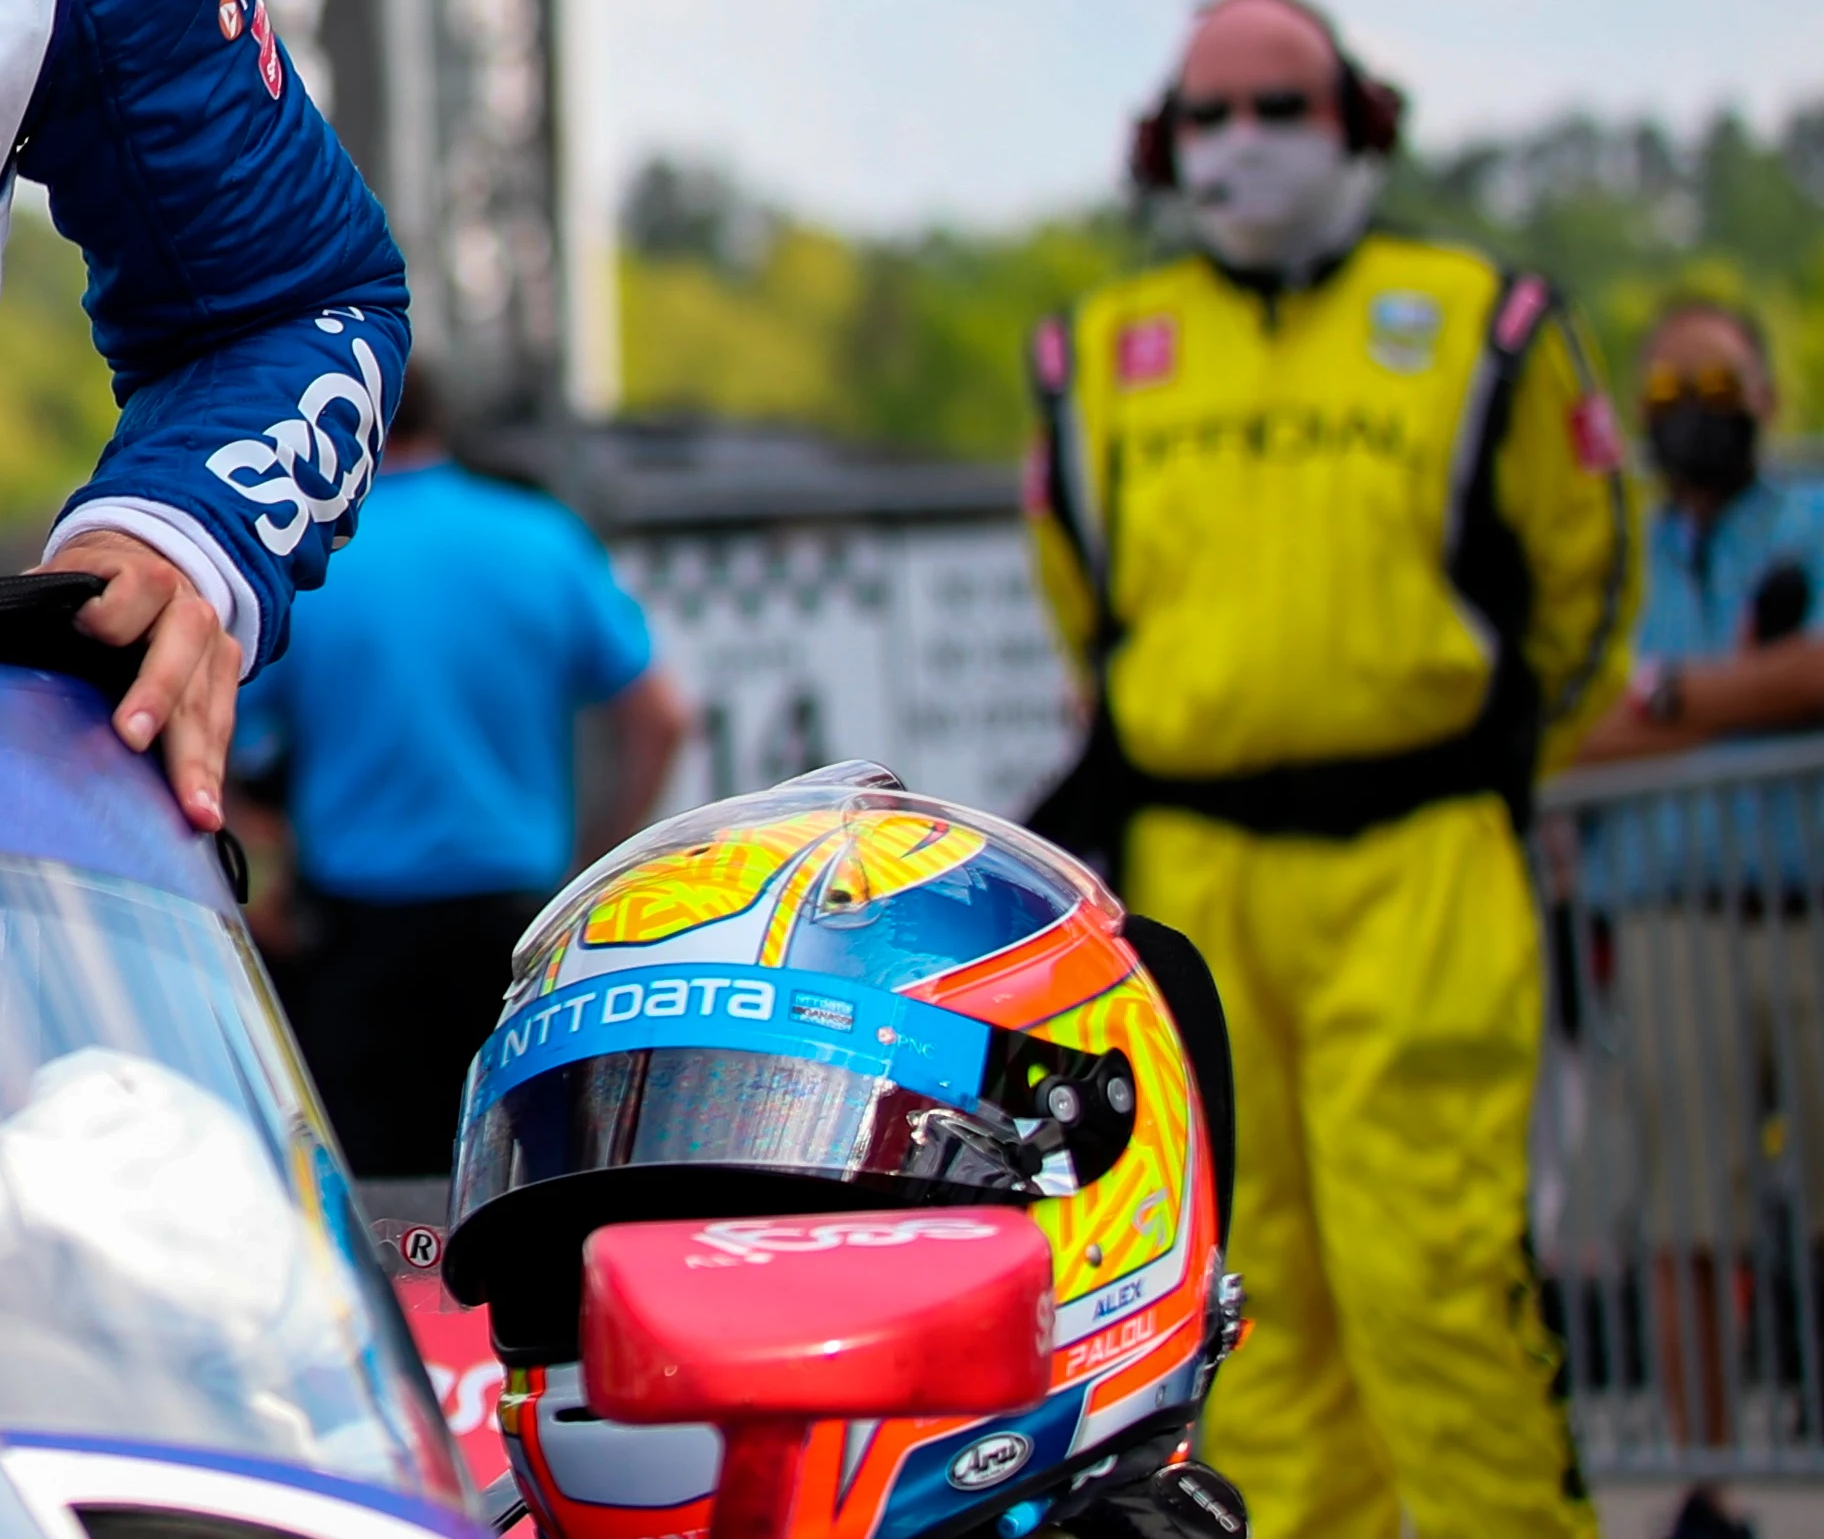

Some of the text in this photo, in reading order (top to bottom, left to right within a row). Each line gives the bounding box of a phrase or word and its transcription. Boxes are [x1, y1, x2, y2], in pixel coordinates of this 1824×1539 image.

[500, 991, 597, 1069] NTT
[1093, 1277, 1144, 1322] ALEX
[1065, 1308, 1157, 1378] PALOU
[1177, 1476, 1242, 1533] ZERO
